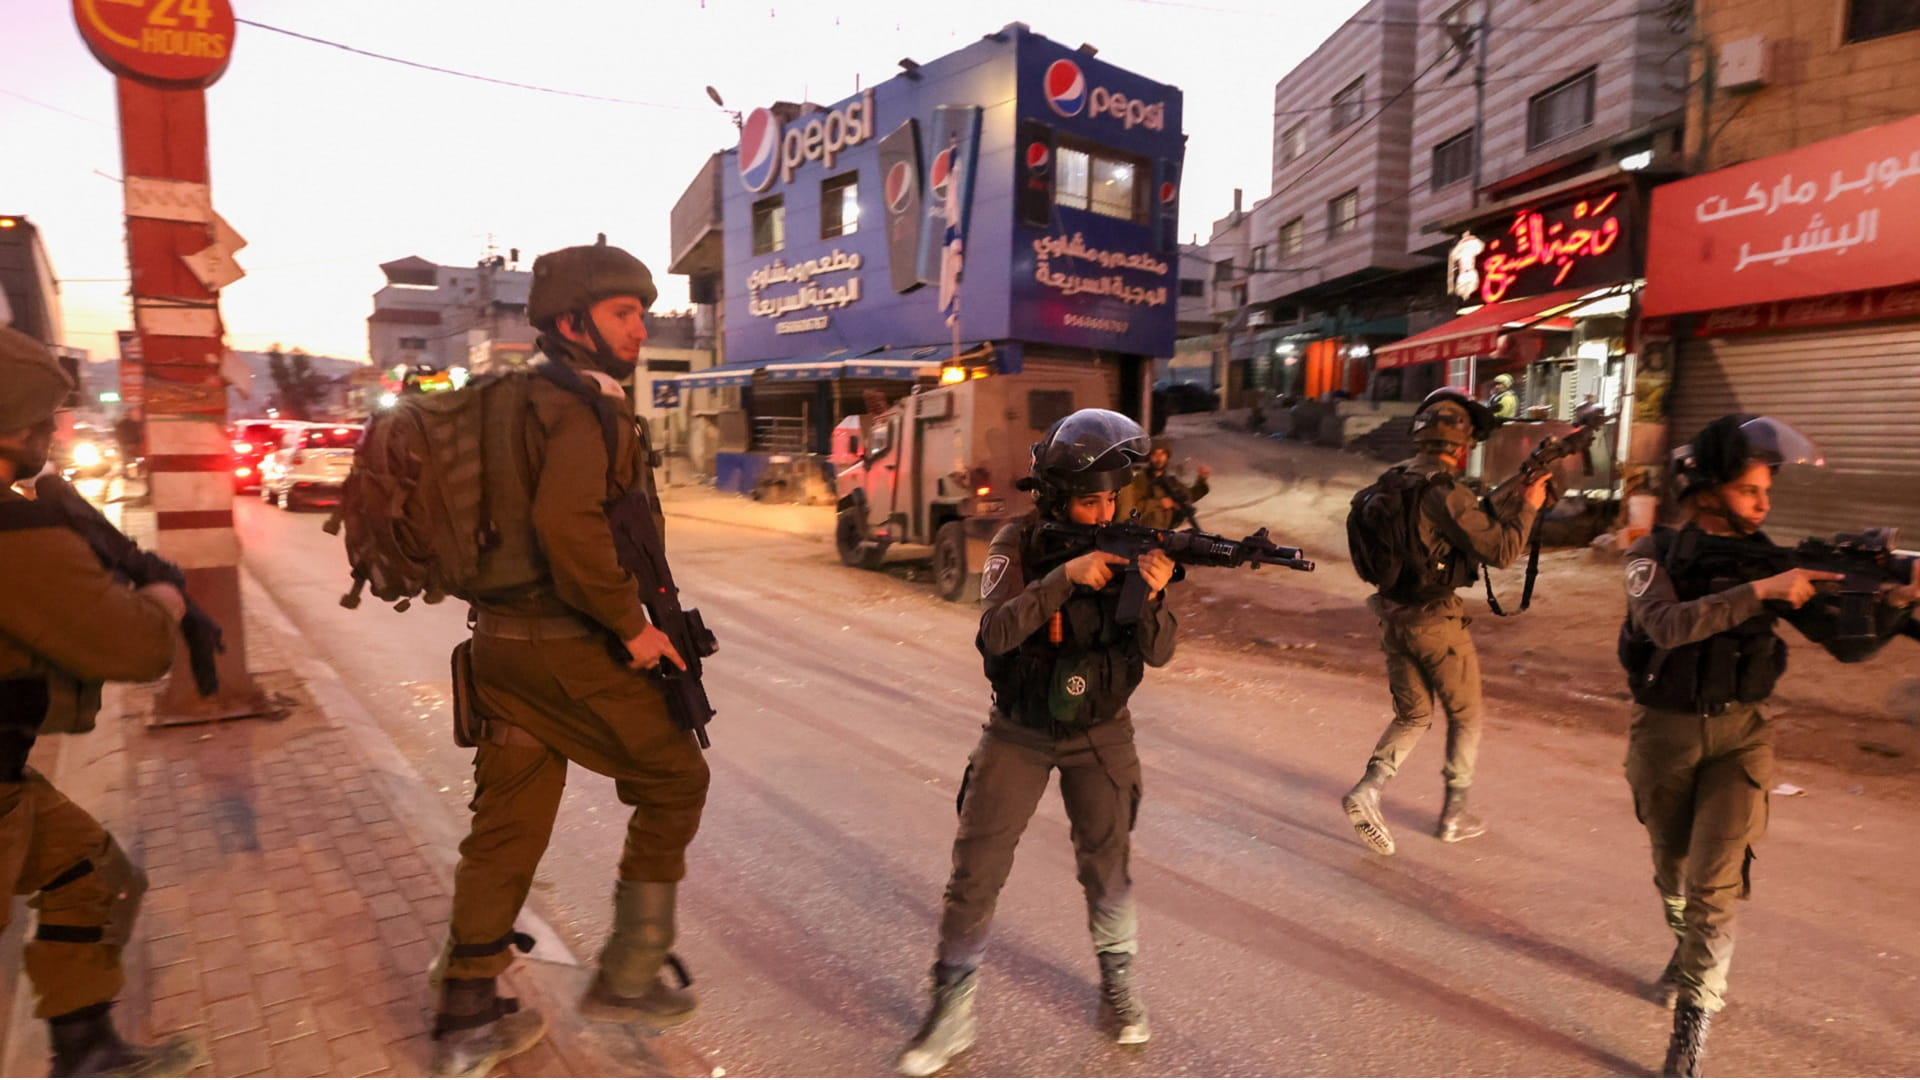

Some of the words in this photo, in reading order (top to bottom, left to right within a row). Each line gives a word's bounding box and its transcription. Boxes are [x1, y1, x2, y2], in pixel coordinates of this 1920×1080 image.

[141, 27, 226, 59] HOURS
[1088, 86, 1166, 132] pepsi
[781, 88, 876, 184] pepsi
[1695, 173, 1818, 223] ماركت
[1732, 206, 1881, 273] البشير
[807, 276, 861, 311] الوجبة
